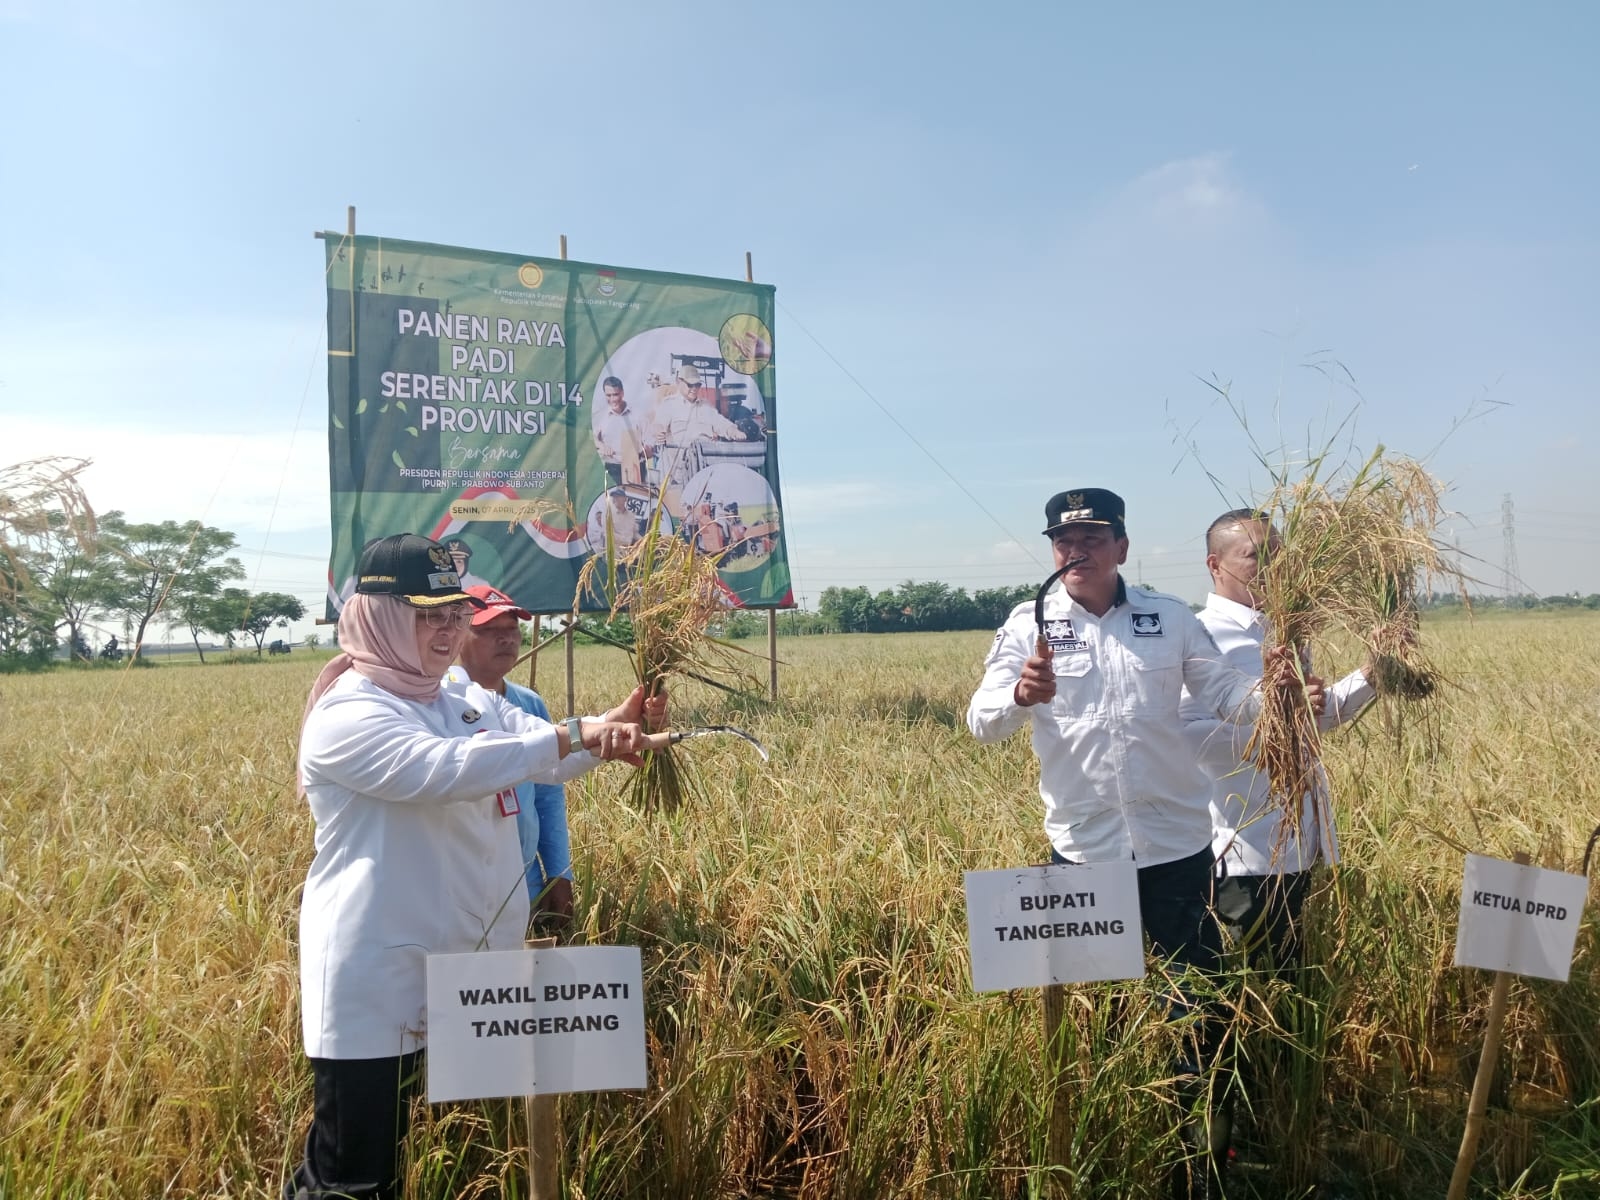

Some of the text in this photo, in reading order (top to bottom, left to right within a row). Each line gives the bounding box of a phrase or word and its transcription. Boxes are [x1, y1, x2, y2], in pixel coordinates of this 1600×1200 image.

[398, 309, 565, 347] PANEN RAYA
[452, 345, 514, 374] PADI
[380, 371, 584, 407] SERENTAK DI 14
[421, 405, 546, 435] PROVINSI
[448, 436, 520, 468] Bersama
[400, 469, 566, 479] PRESIDEN REPUBLIK INDONESIA JENDERAL
[422, 479, 545, 489] (PURN) H. PRABOWO SUBIANTO
[452, 505, 480, 515] SENIN,
[1020, 892, 1096, 912] BUPATI
[1473, 890, 1568, 921] KETUA DPRD
[995, 919, 1125, 942] TANGERANG
[459, 984, 629, 1006] WAKIL BUPATI
[472, 1015, 620, 1037] TANGERANG
